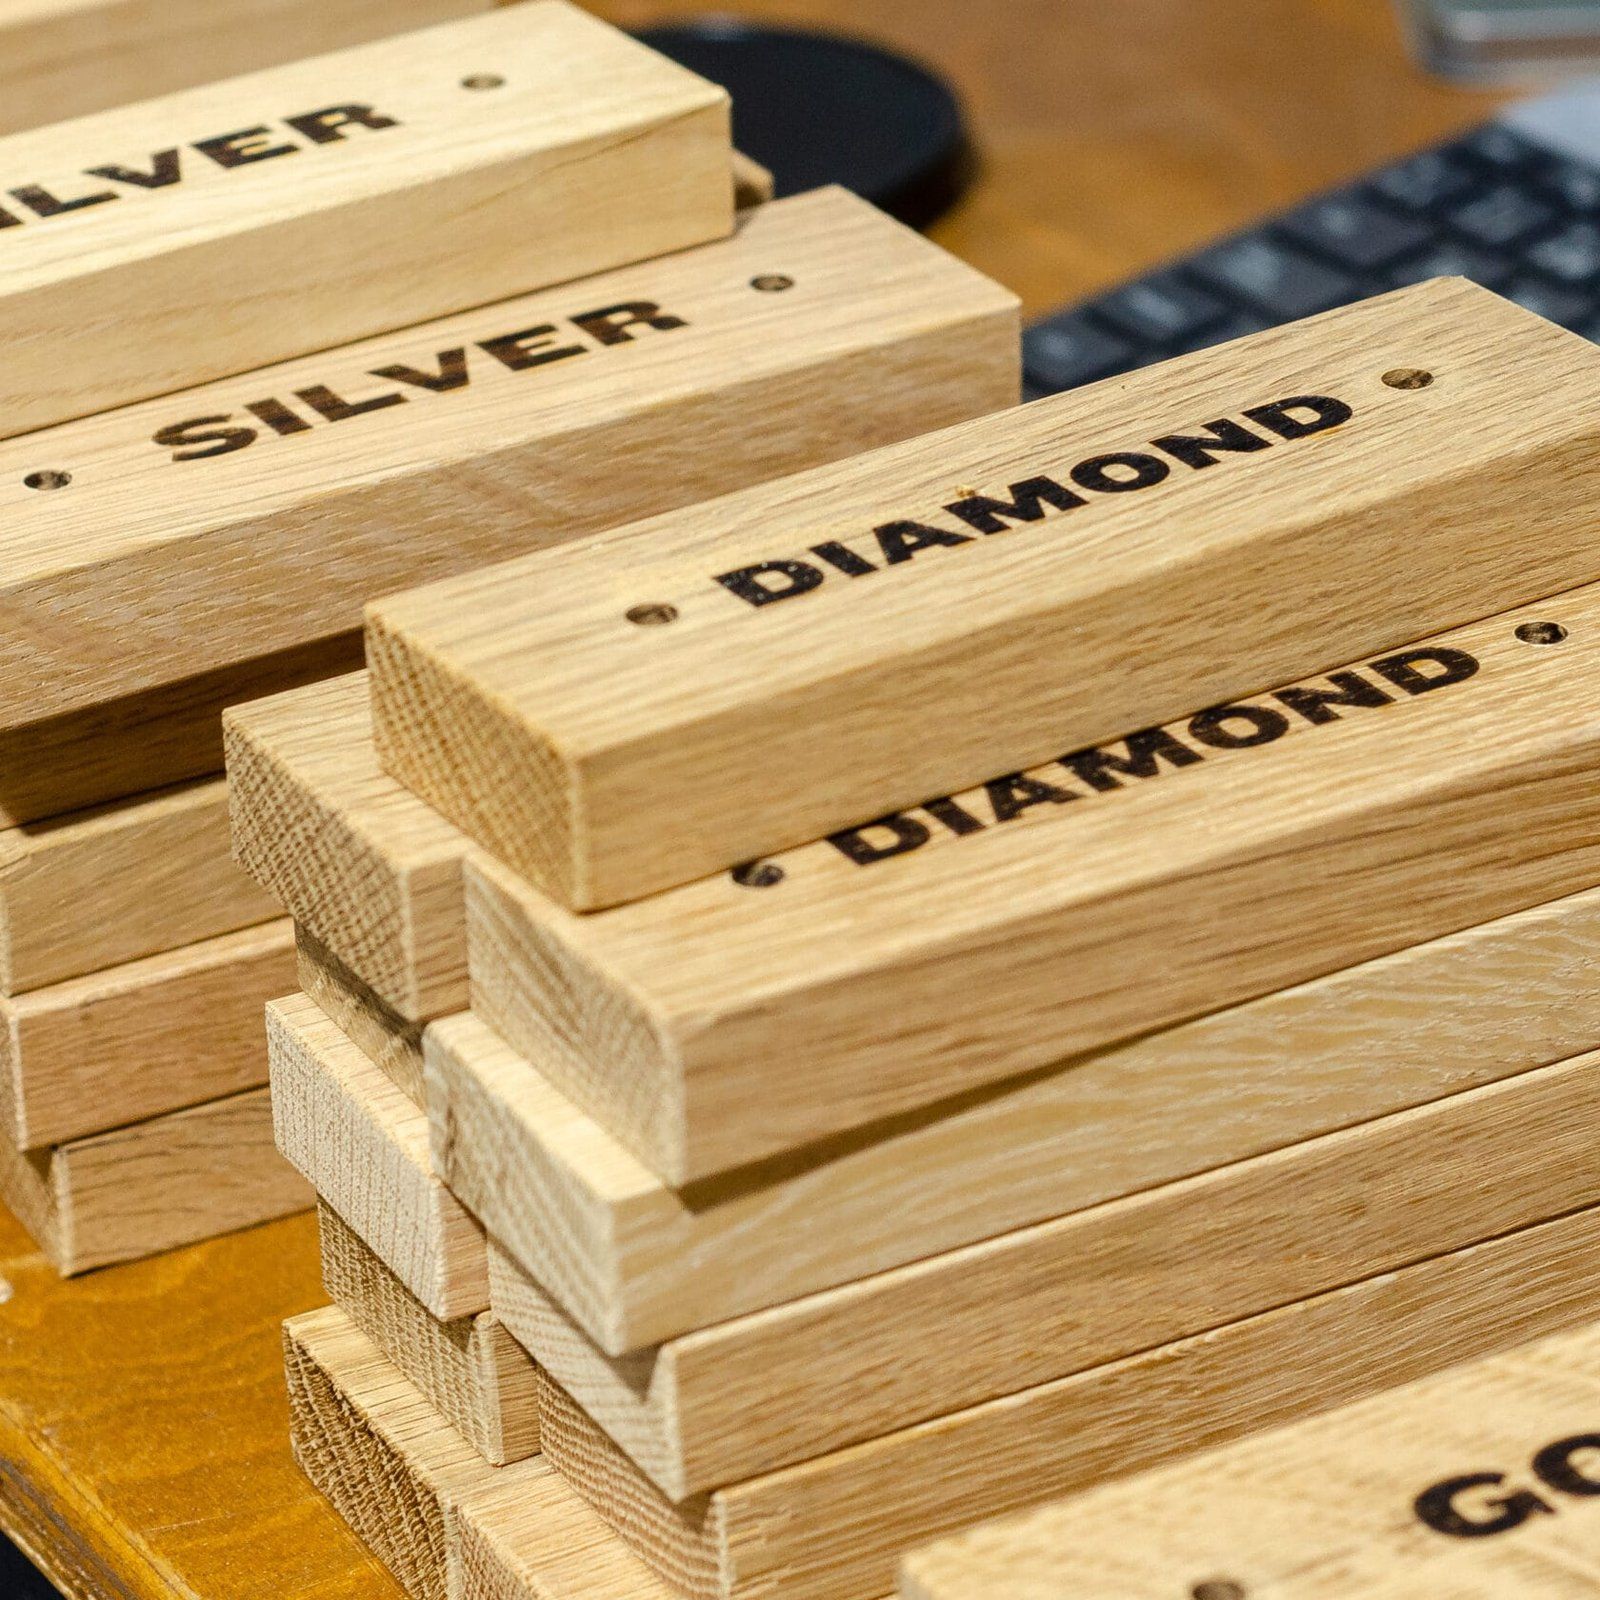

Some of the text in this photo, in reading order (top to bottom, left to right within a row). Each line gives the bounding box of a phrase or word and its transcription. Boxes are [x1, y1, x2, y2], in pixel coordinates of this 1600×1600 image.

[153, 299, 687, 461] SILVER
[713, 394, 1353, 607] DIAMOND
[826, 646, 1480, 865] DIAMOND
